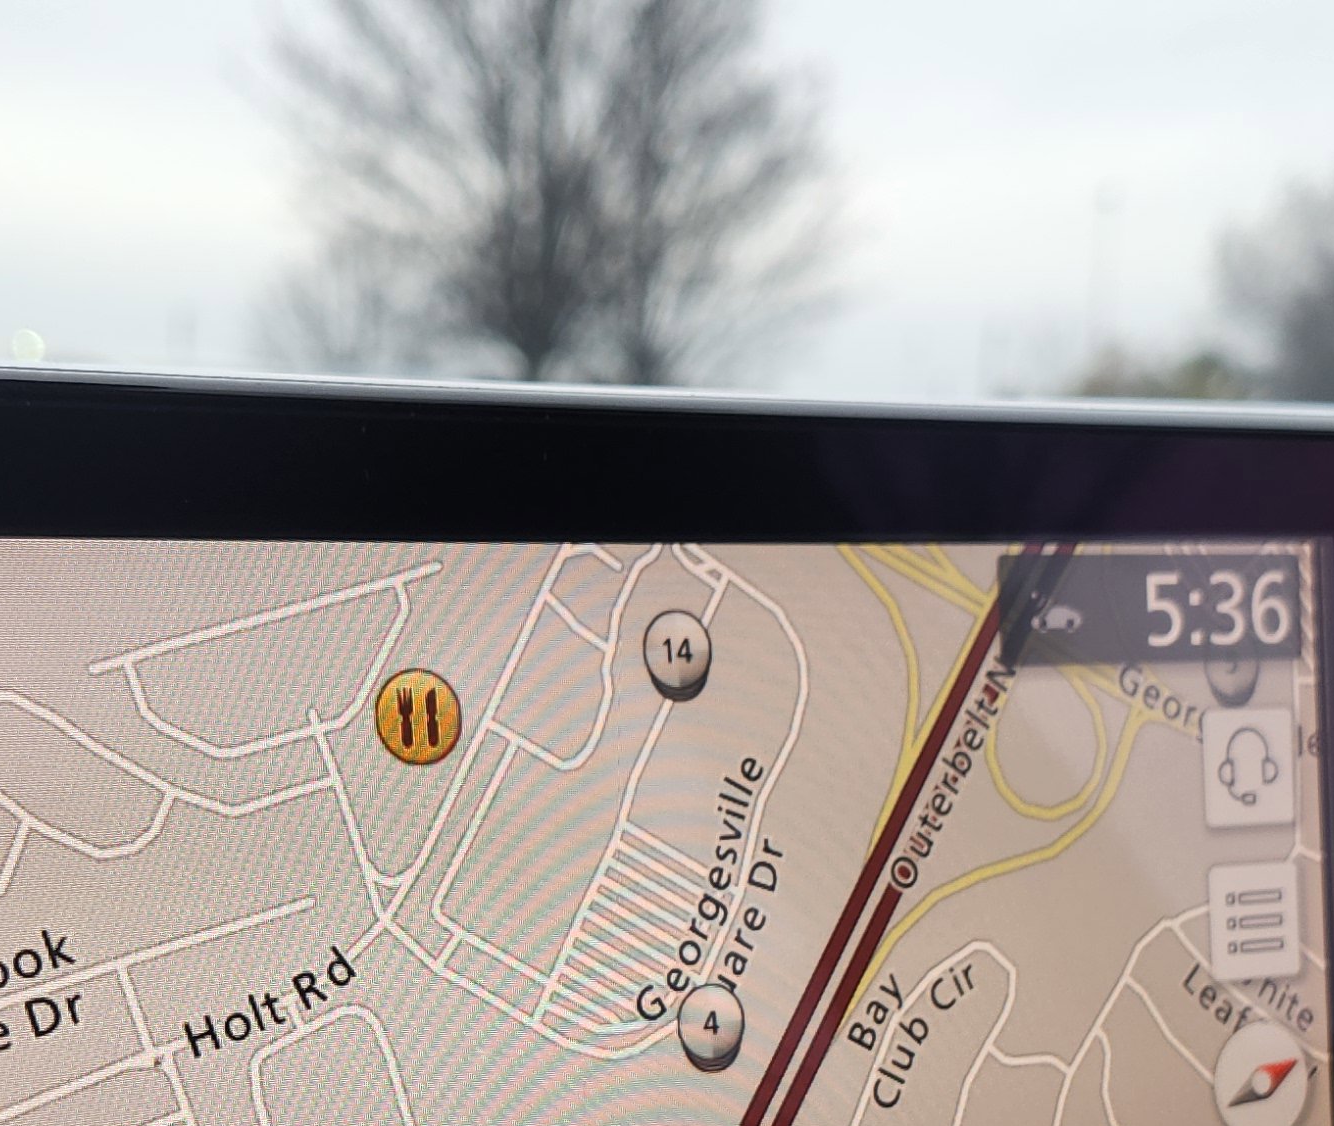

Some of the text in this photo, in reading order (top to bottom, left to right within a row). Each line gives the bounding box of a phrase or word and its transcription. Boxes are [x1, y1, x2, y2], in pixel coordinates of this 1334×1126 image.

[1146, 571, 1288, 646] 5:36
[662, 639, 693, 664] 14
[892, 697, 999, 889] Outerbelt
[636, 756, 764, 1021] Georgesville
[749, 838, 784, 892] Dr
[24, 989, 84, 1038] Dr
[183, 945, 356, 1058] Holt Rd
[703, 1010, 720, 1036] 4
[847, 973, 904, 1051] Bay
[873, 961, 976, 1109] Club Cir
